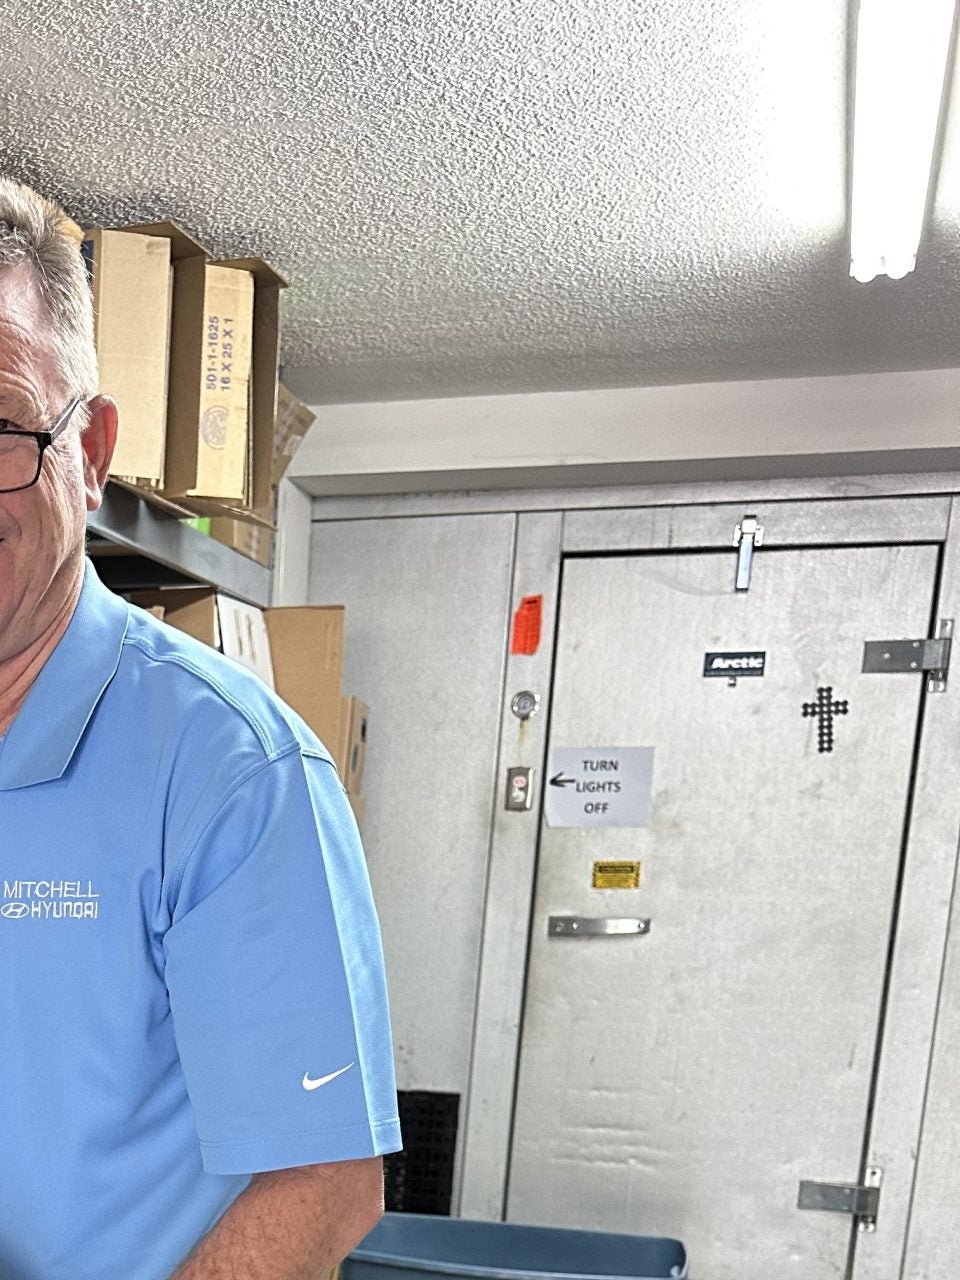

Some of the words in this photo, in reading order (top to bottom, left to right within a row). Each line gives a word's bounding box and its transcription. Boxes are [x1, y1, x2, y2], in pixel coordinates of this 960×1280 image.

[207, 316, 220, 390] 501-1-1625
[222, 343, 232, 358] 25
[582, 760, 619, 771] TURN
[576, 781, 621, 793] LIGHTS
[584, 802, 610, 814] OFF
[3, 880, 100, 898] MITCHELL
[31, 900, 98, 919] HYUNDAI
